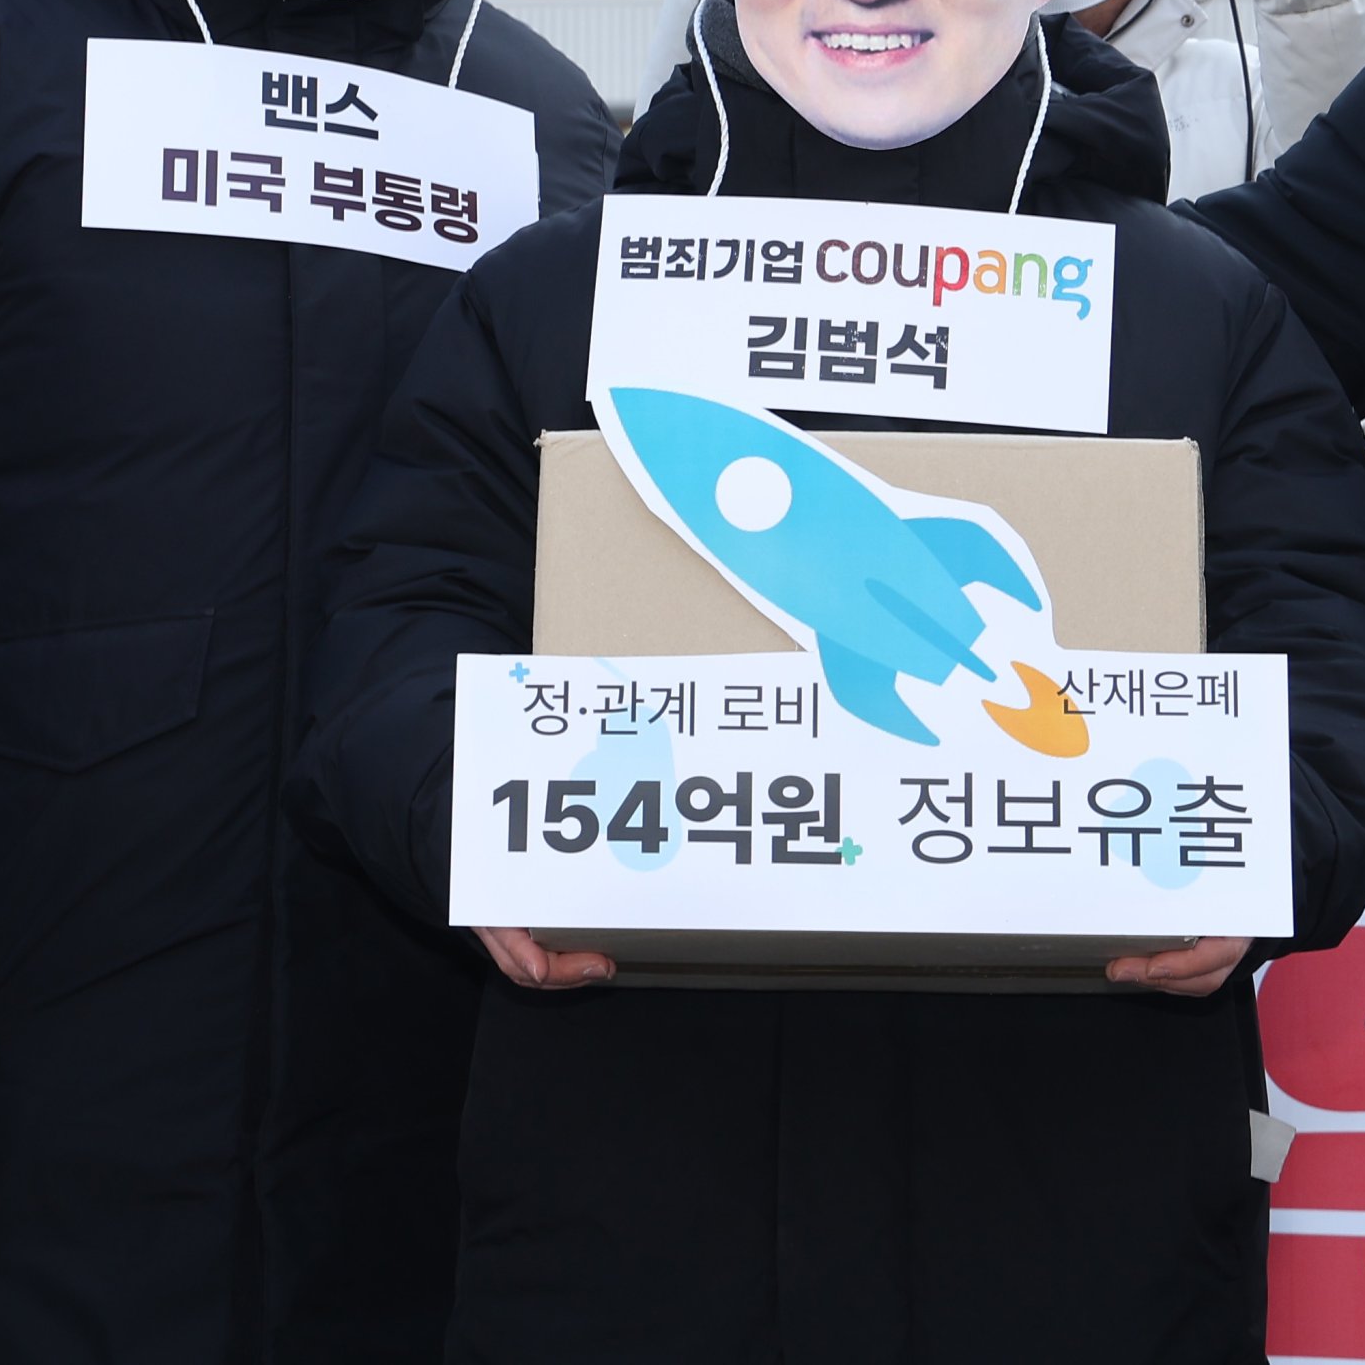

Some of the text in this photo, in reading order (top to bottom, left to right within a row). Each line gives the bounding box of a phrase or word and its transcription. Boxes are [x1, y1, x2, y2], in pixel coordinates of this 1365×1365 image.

[262, 71, 379, 140] 밴스
[162, 147, 479, 244] 미국 부통령
[620, 236, 1093, 320] 범죄기업 coupang
[747, 316, 949, 390] 김범석
[522, 680, 821, 739] 정·관계 로비
[1056, 668, 1240, 718] 산재은폐
[491, 772, 843, 866] 154억원
[897, 774, 1253, 869] 정보유출
